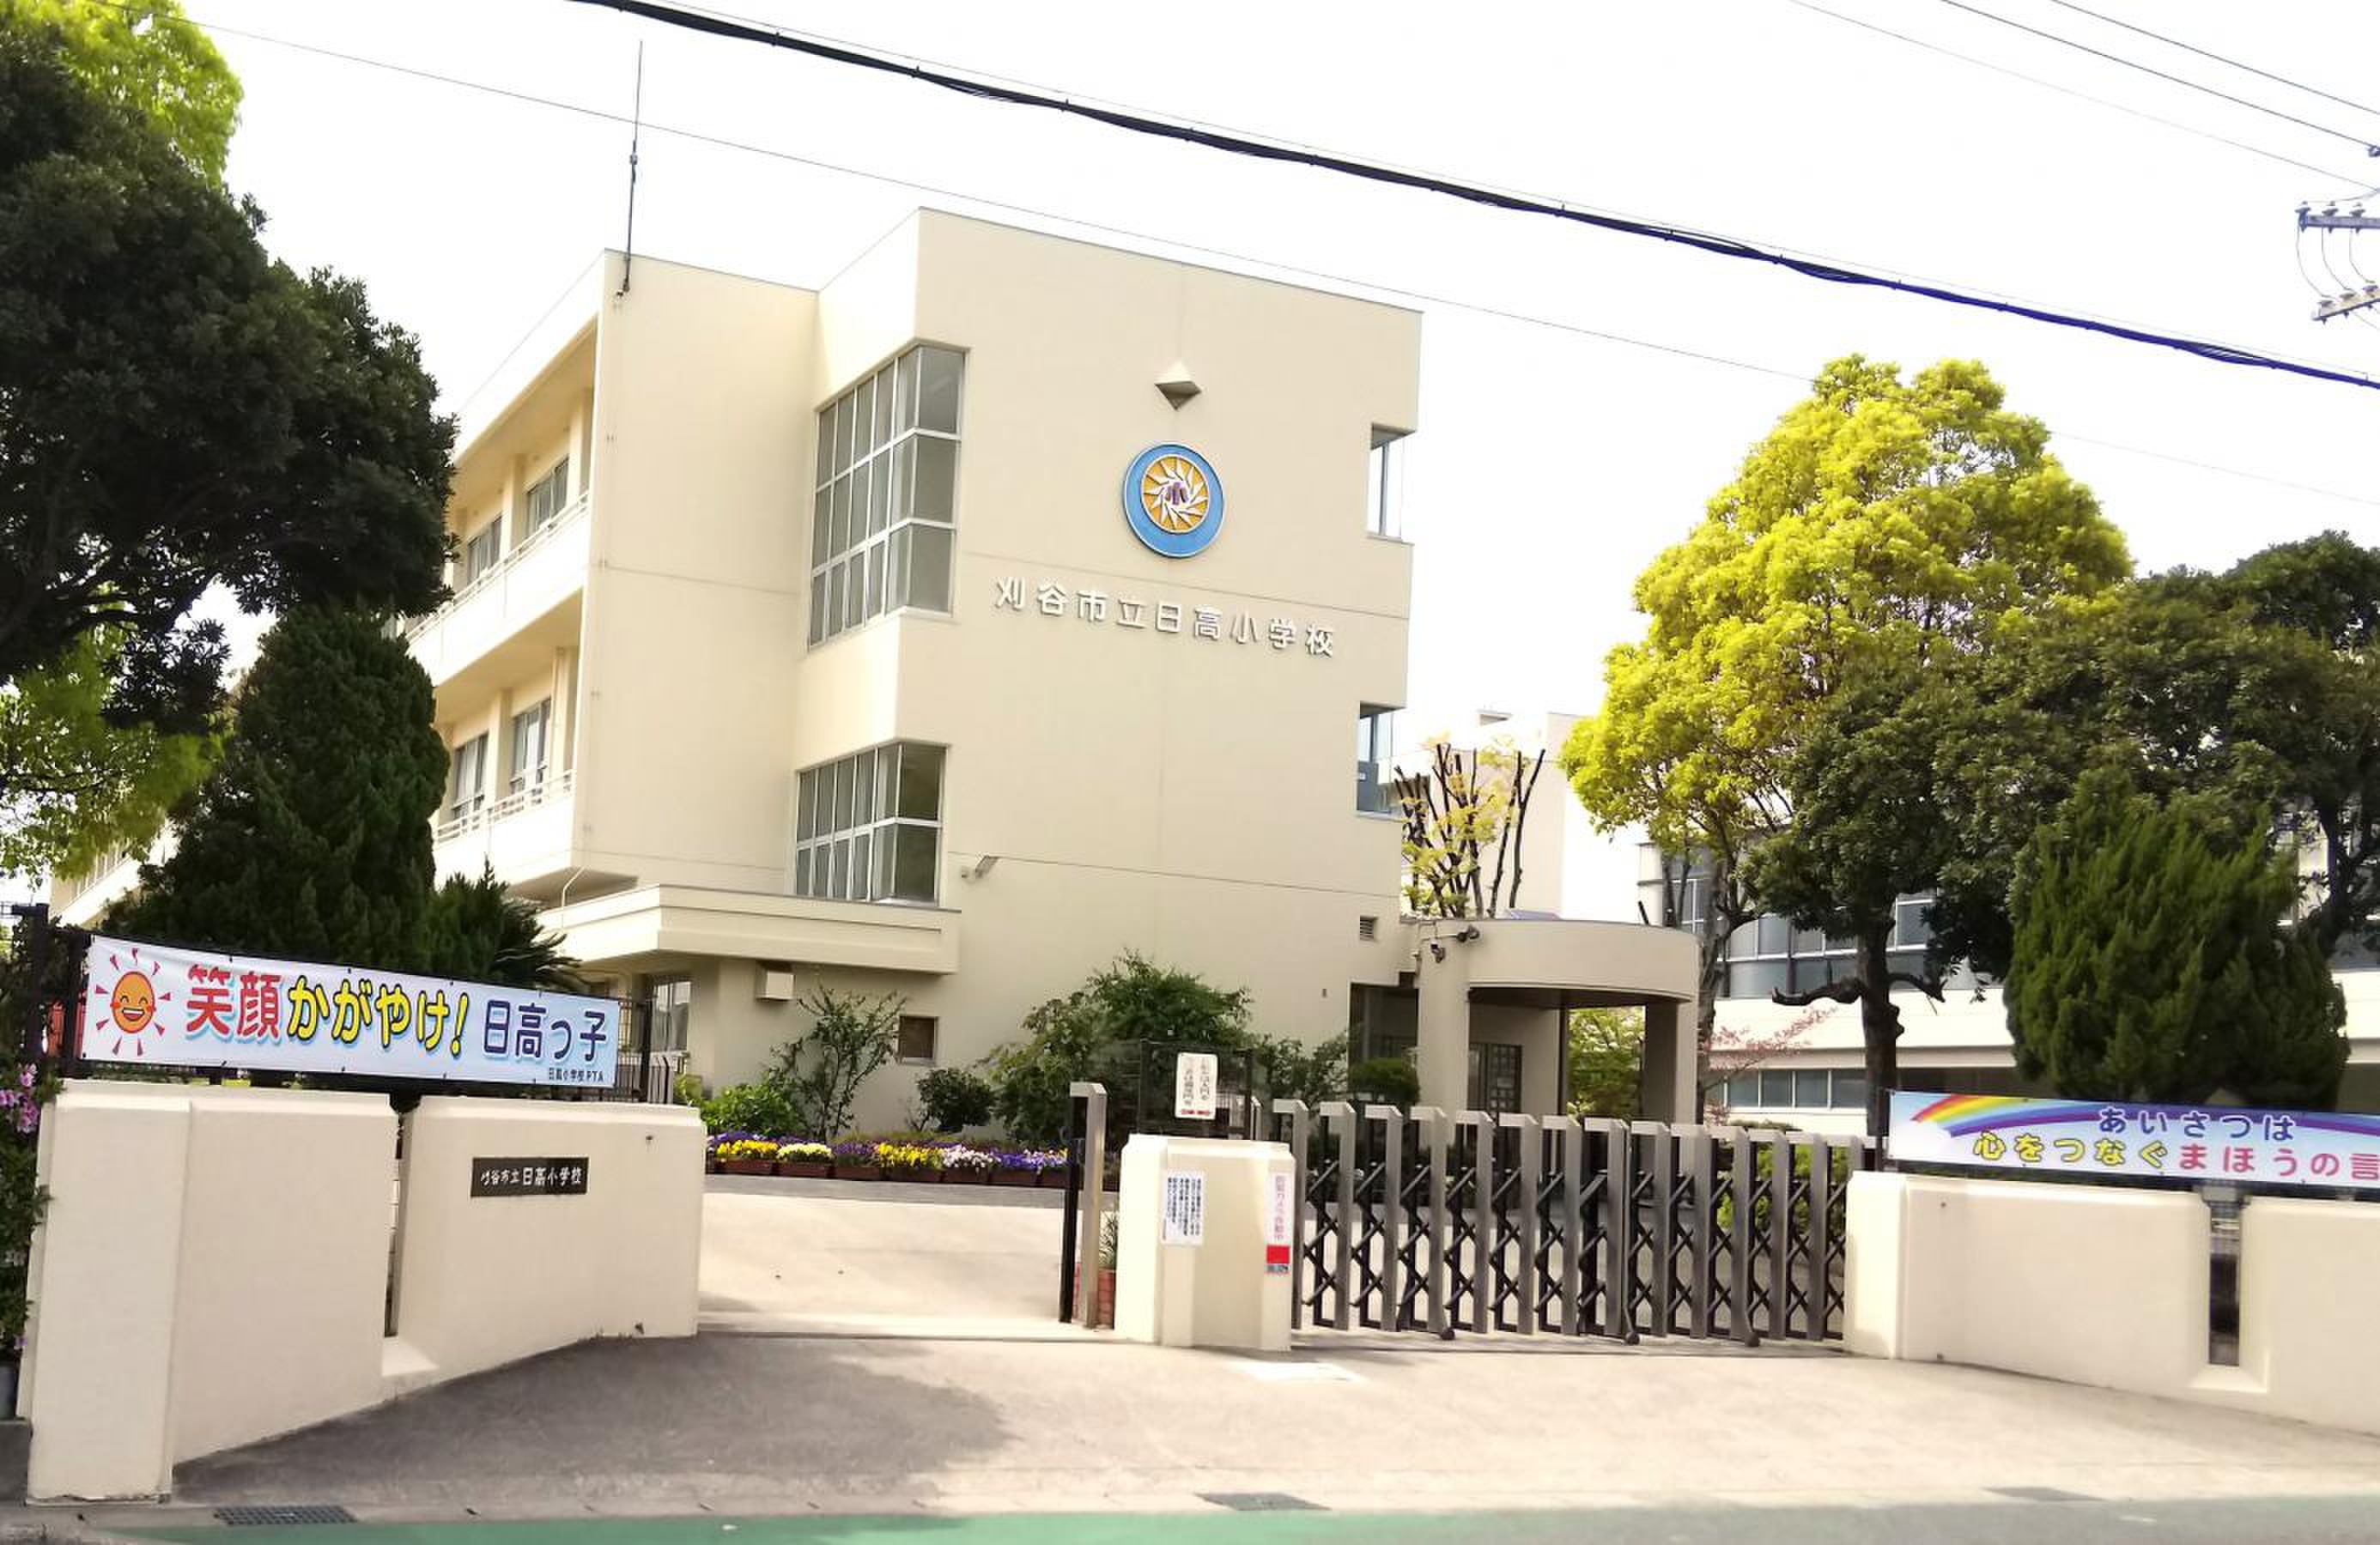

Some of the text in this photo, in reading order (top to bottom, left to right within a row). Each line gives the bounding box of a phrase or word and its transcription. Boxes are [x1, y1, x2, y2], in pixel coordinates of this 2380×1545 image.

[995, 576, 1333, 657] 刈谷市立日高小学校
[2098, 1106, 2295, 1142] あいさつは
